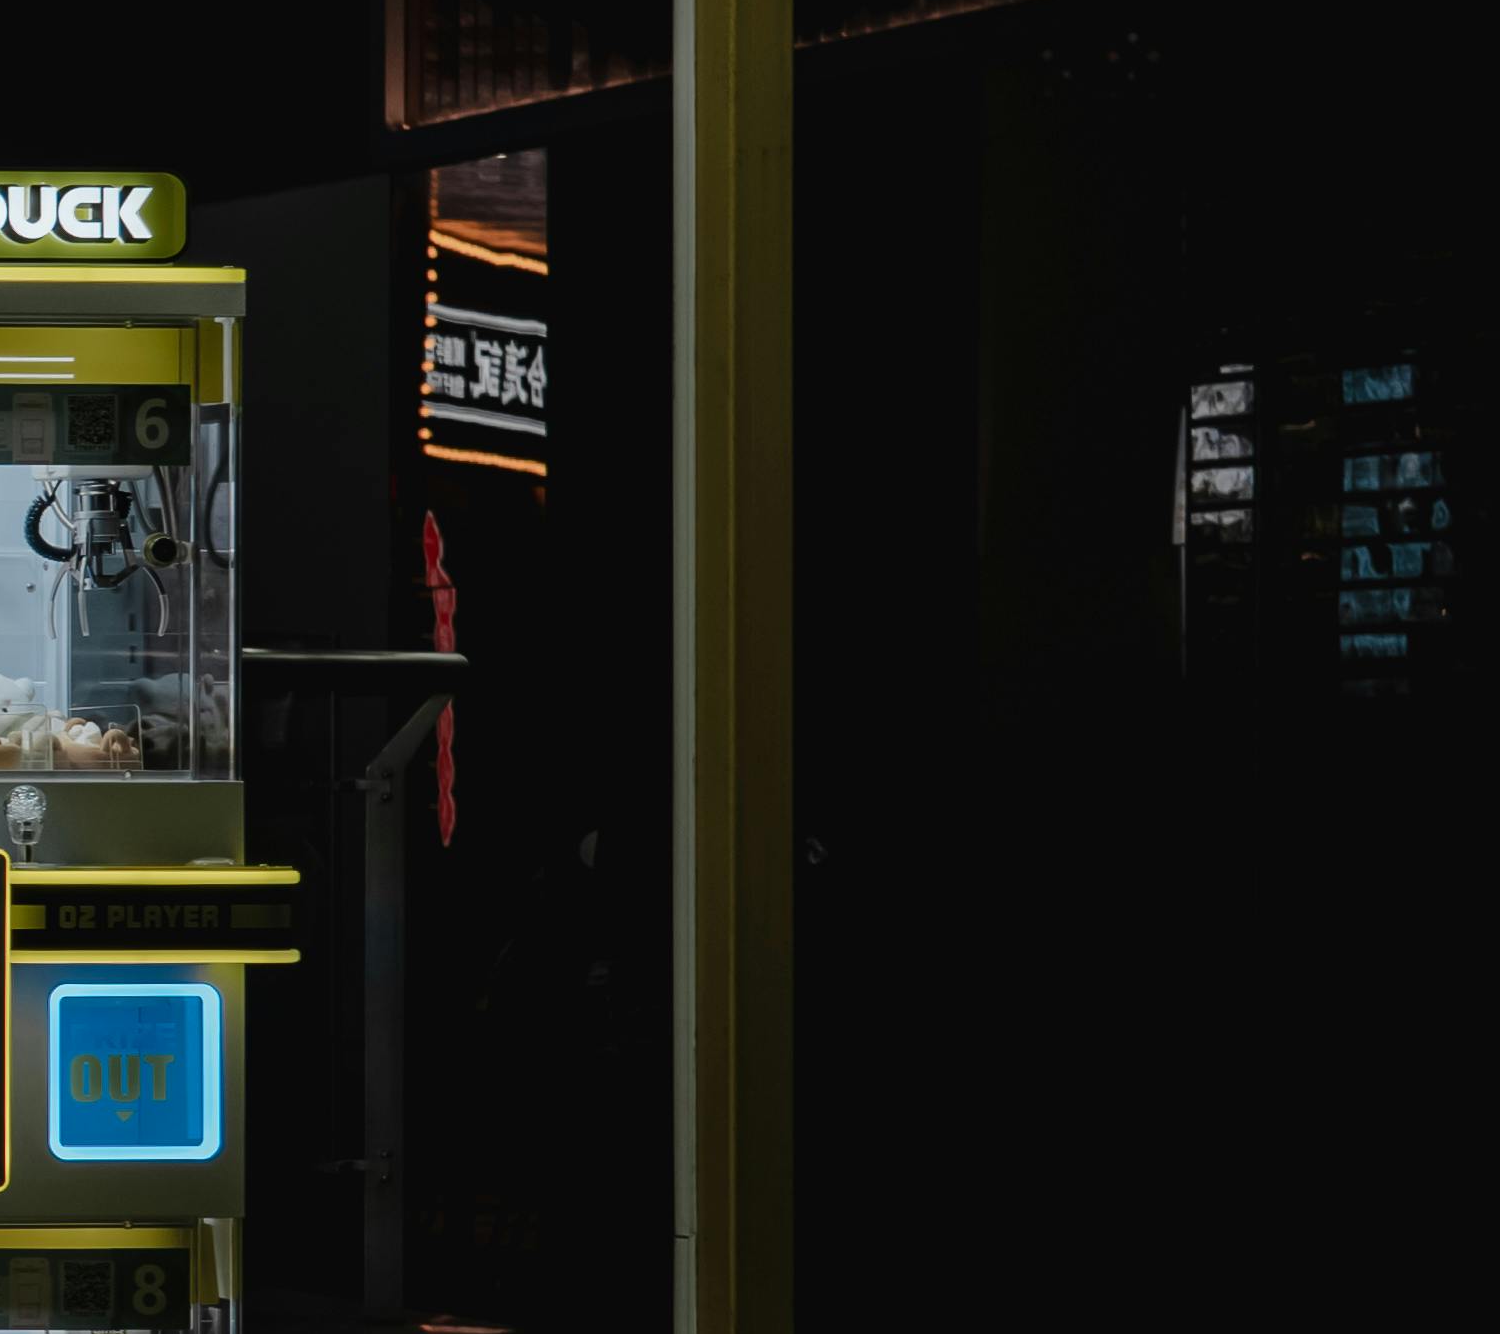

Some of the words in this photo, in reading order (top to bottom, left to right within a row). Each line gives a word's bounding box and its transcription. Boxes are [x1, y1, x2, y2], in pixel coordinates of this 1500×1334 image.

[133, 398, 170, 450] 6
[106, 904, 220, 930] PLAYER
[70, 1053, 176, 1103] OUT
[132, 1263, 167, 1317] 8
